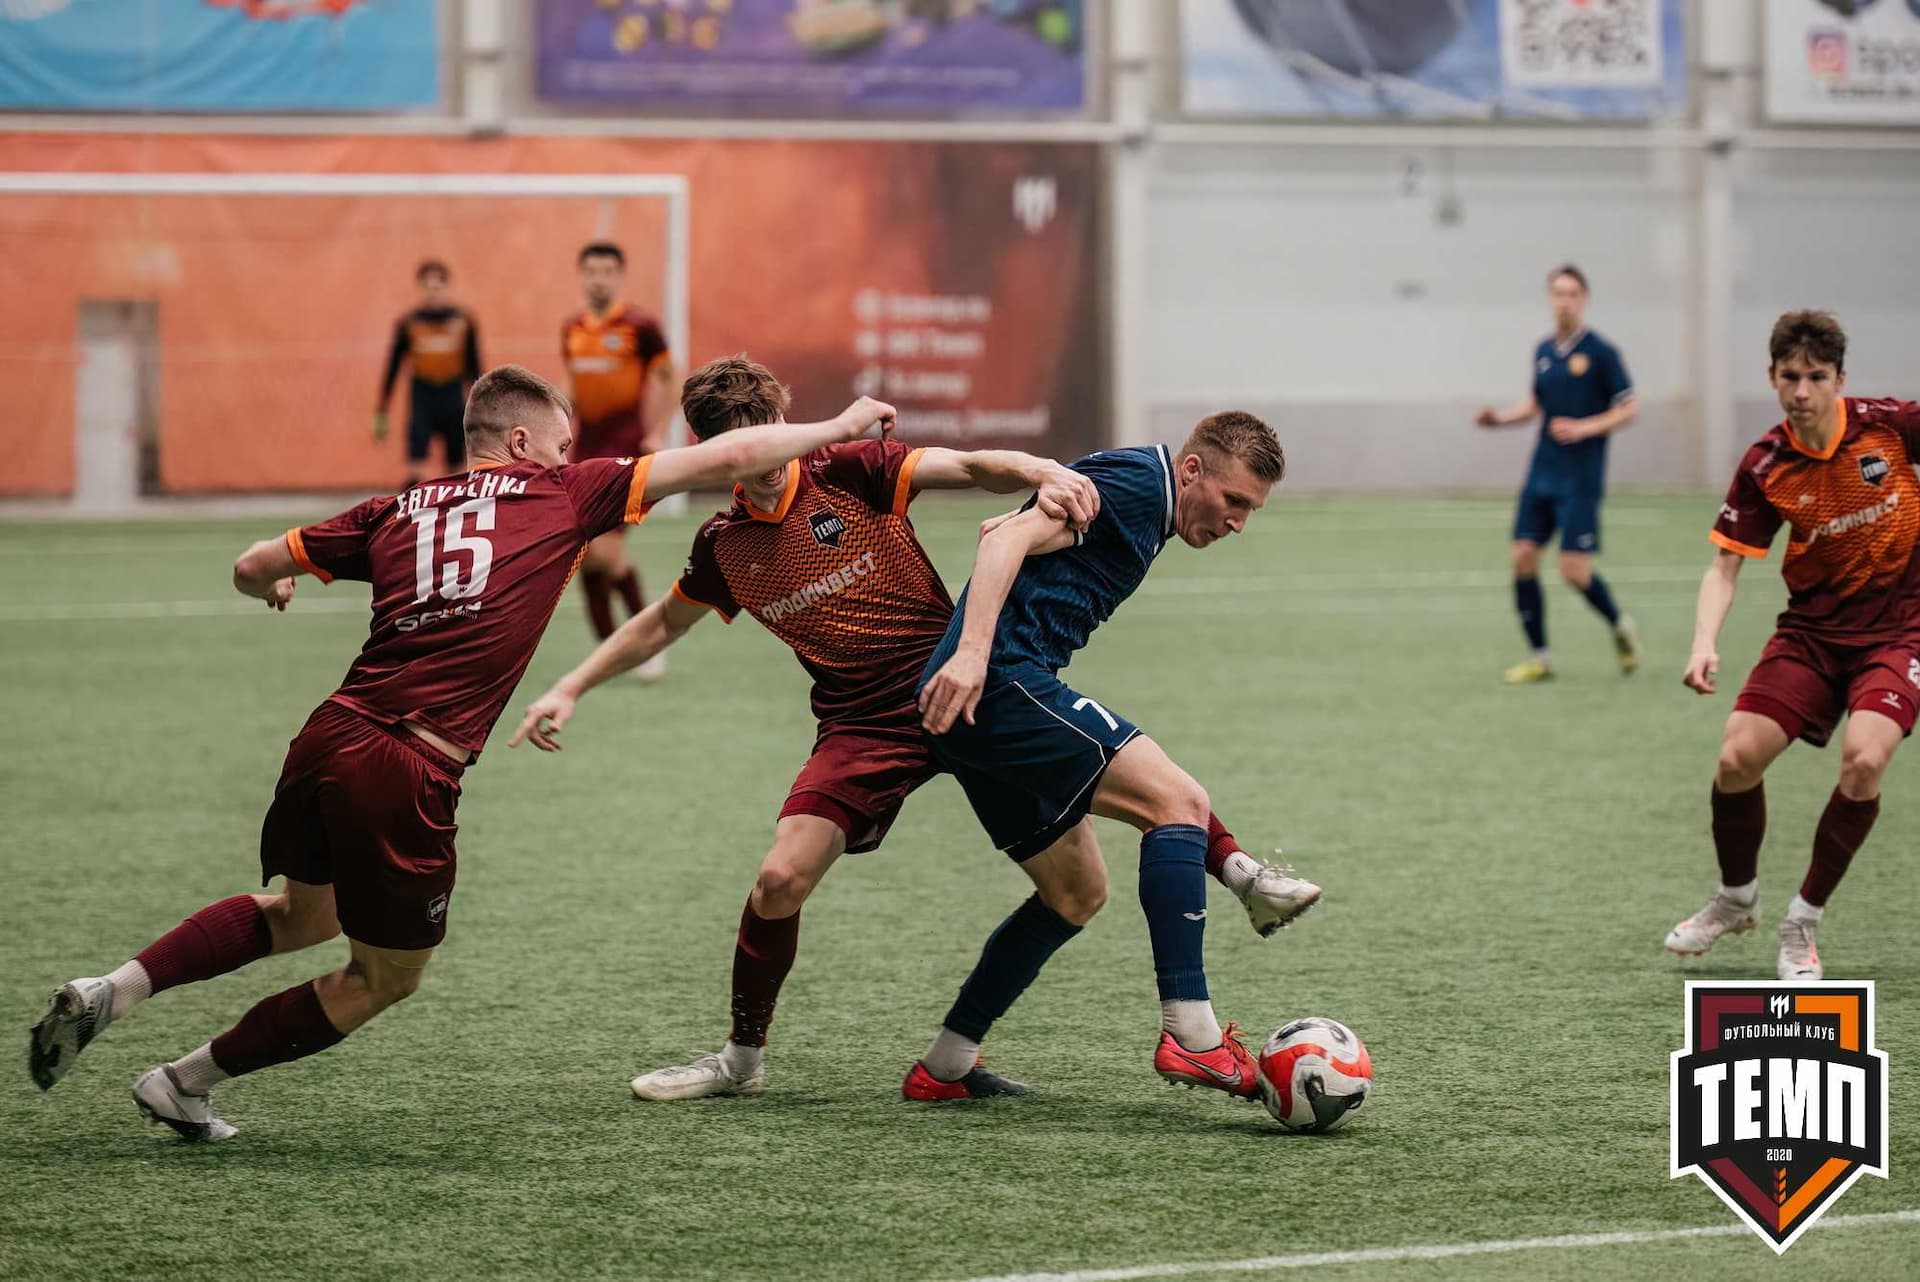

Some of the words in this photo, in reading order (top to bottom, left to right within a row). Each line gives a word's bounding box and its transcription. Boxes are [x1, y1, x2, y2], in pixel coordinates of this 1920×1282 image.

[814, 518, 844, 540] ТЕМП
[411, 496, 496, 605] 15
[1072, 697, 1119, 732] 7
